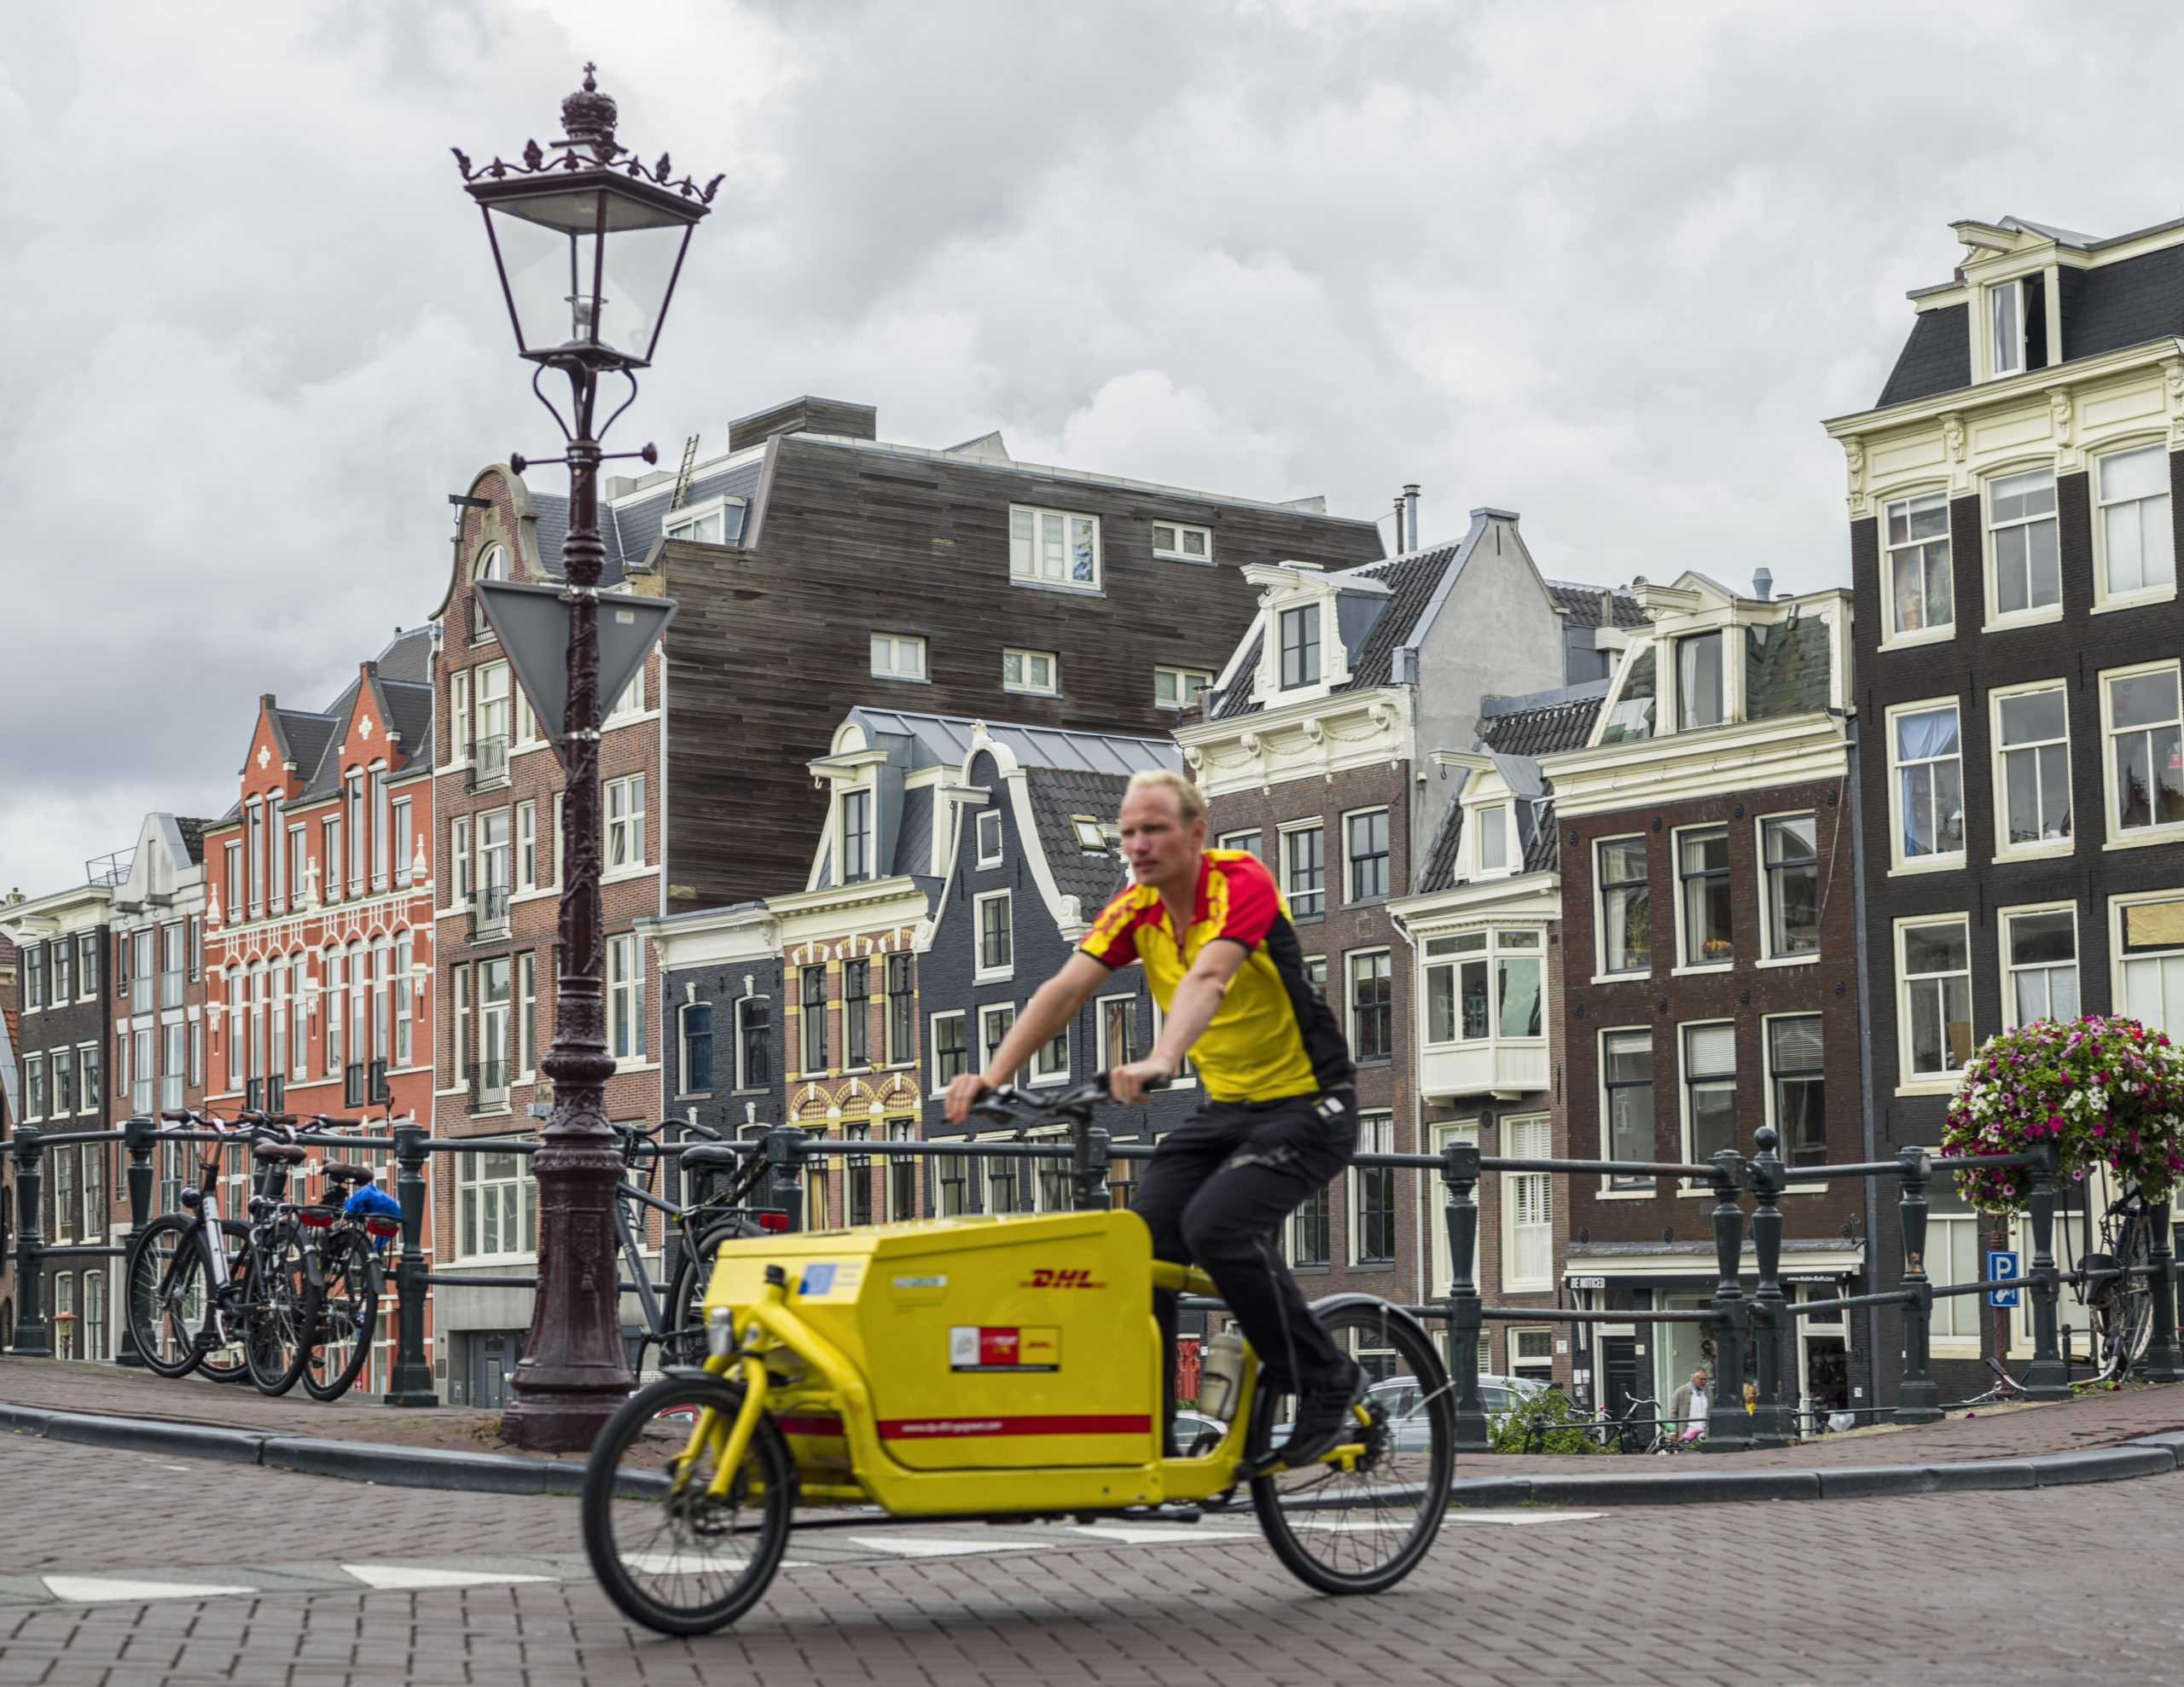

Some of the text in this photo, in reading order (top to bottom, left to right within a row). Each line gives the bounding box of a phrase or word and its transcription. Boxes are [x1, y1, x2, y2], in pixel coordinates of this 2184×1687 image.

[1995, 1256, 2013, 1281] P
[1028, 1269, 1094, 1288] DHL
[1570, 1277, 1606, 1289] BE NOTICED
